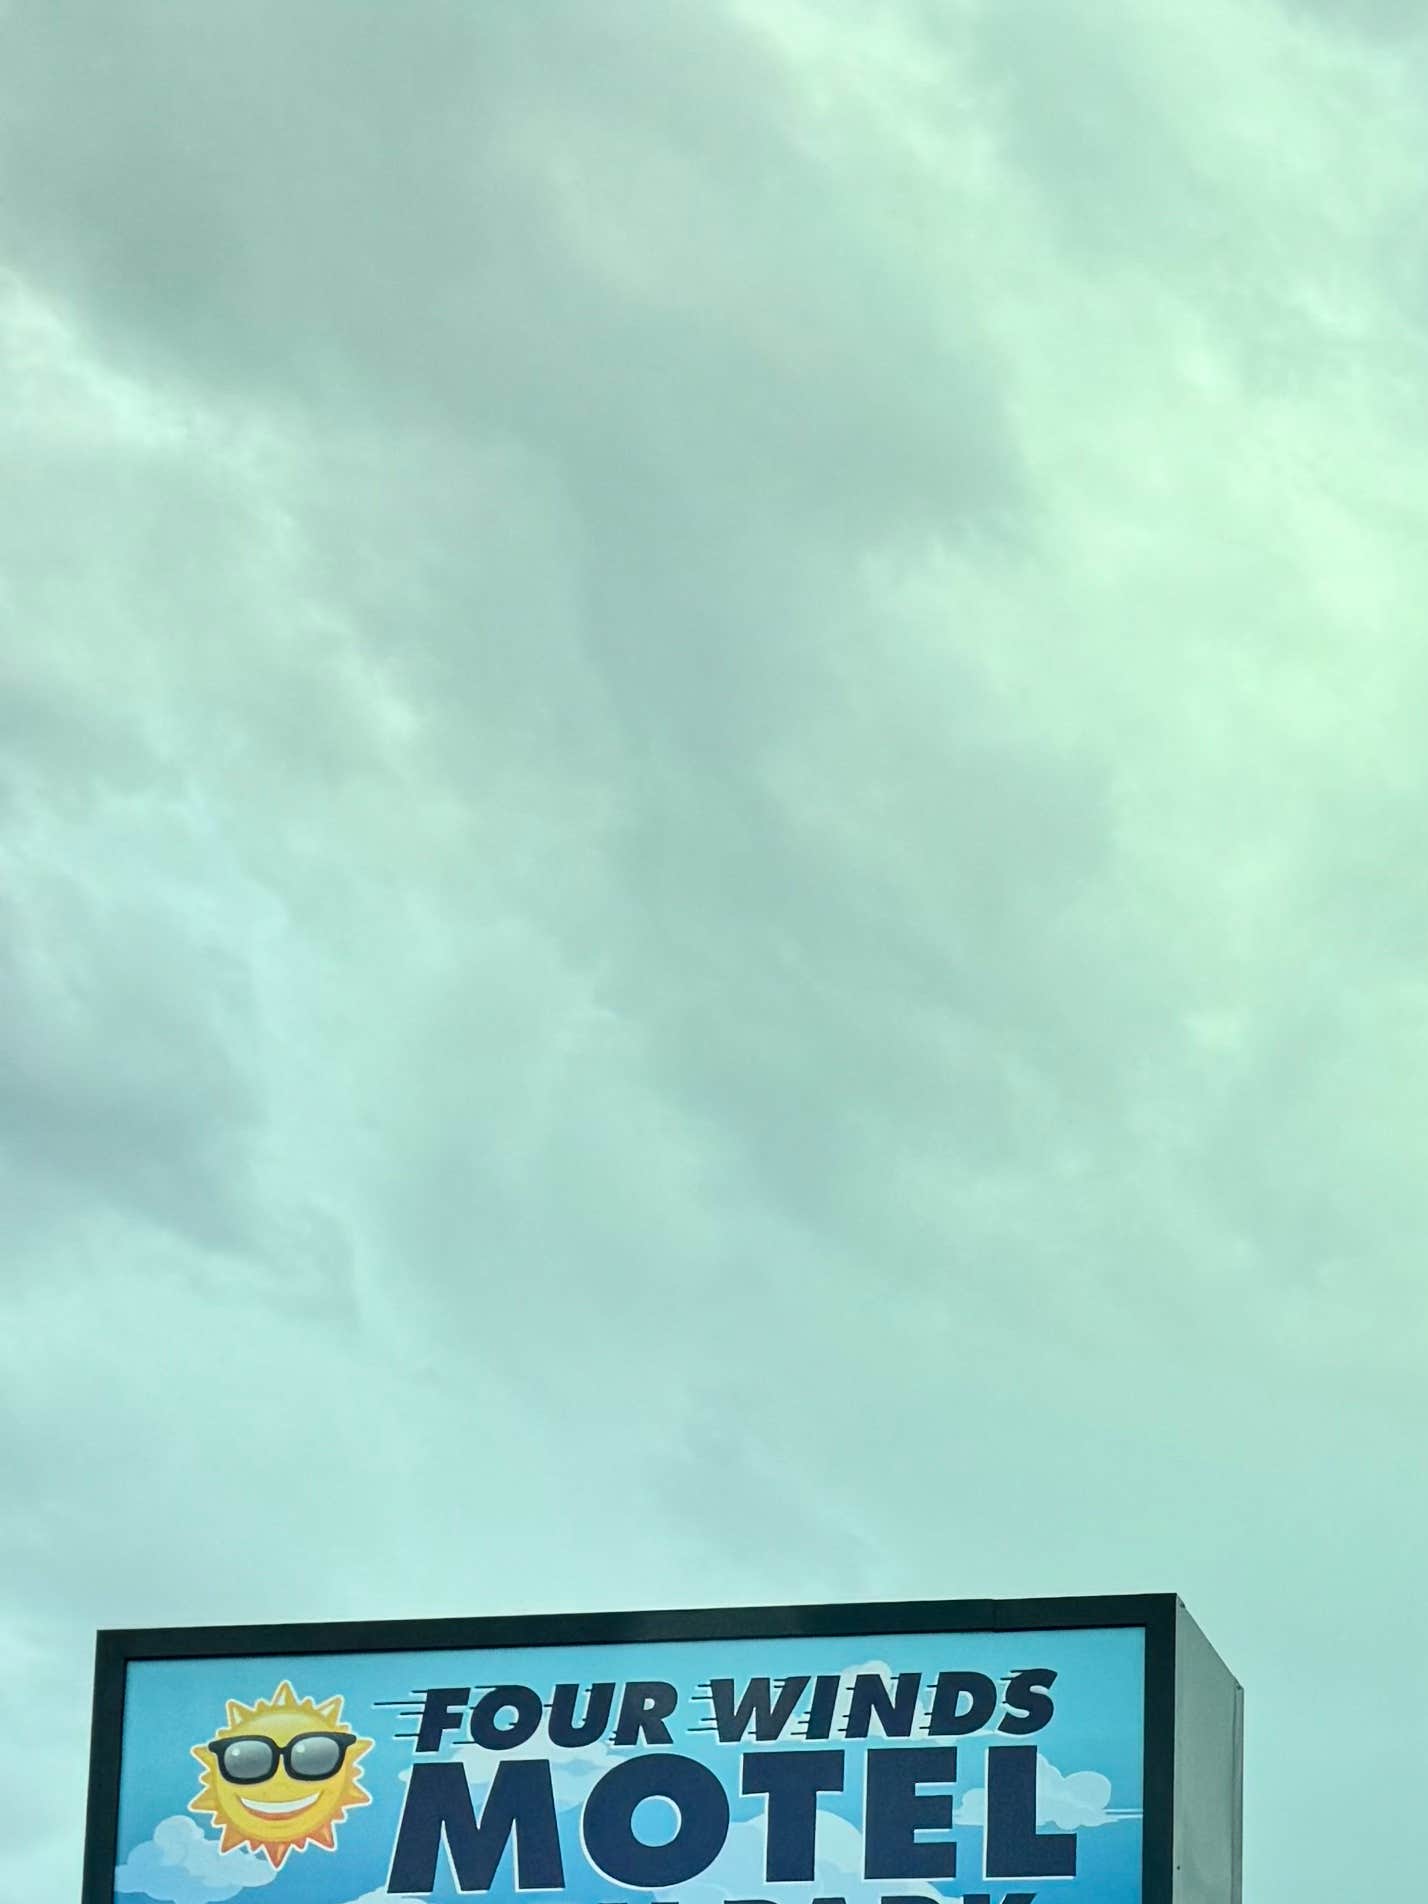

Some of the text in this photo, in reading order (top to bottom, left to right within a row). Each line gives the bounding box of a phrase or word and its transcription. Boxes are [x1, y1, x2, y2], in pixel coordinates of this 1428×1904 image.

[408, 1667, 1058, 1753] FOUR WINDS
[386, 1744, 1078, 1895] MOTEL
